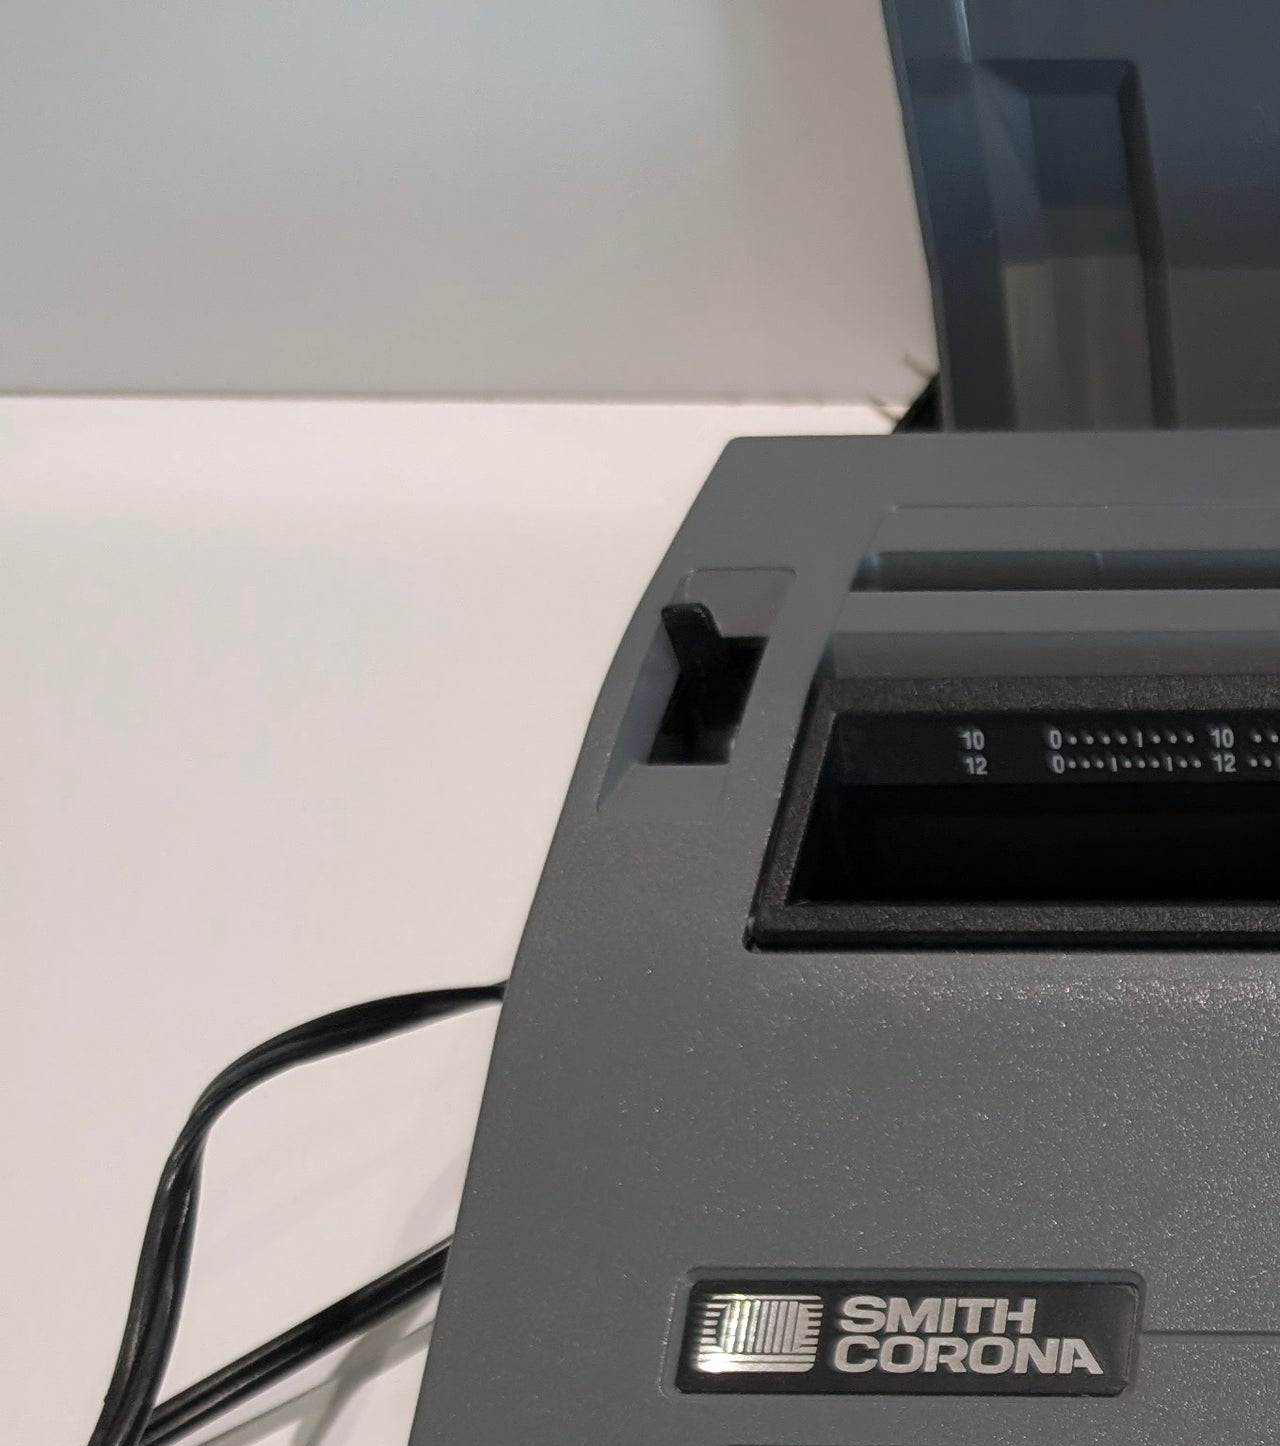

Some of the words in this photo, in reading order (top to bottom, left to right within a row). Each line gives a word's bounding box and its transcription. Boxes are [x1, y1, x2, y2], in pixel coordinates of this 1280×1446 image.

[961, 730, 984, 750] 10
[1049, 729, 1062, 749] 0
[1211, 728, 1234, 748] 10
[964, 756, 987, 775] 12
[1051, 755, 1065, 773] 0
[1213, 753, 1236, 772] 12
[839, 1296, 1036, 1333] SMITH
[834, 1335, 1103, 1374] CORONA
